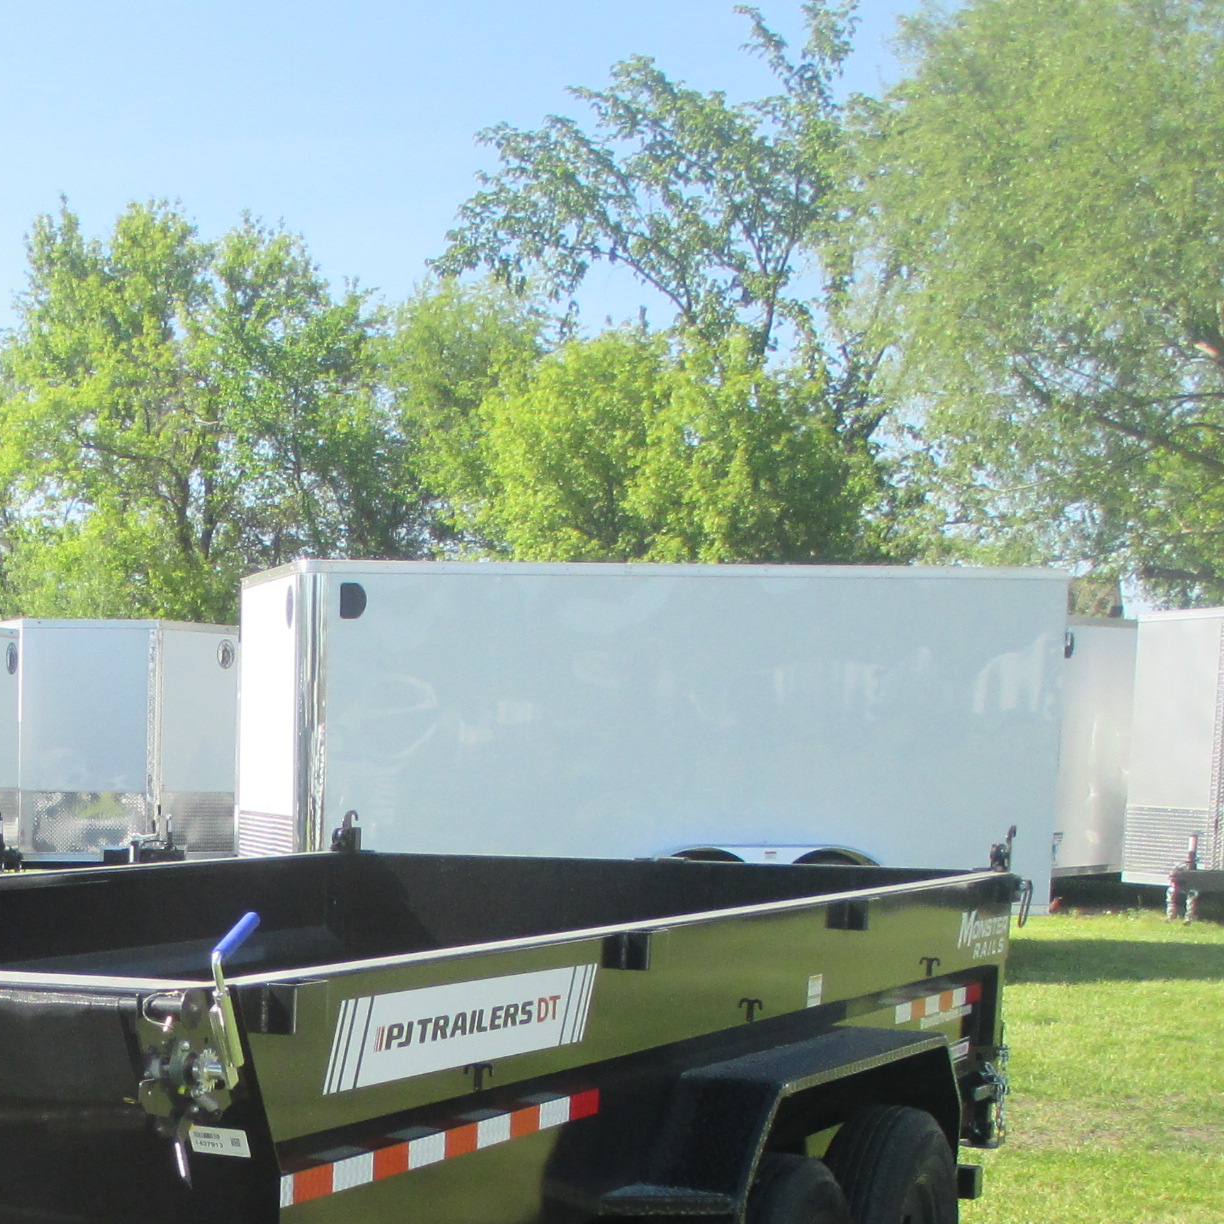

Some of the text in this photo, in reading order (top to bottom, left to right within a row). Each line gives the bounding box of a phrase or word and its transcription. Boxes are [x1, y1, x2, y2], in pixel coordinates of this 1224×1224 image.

[972, 937, 1005, 960] RAILS
[385, 994, 561, 1051] PJ TRAILERS DT
